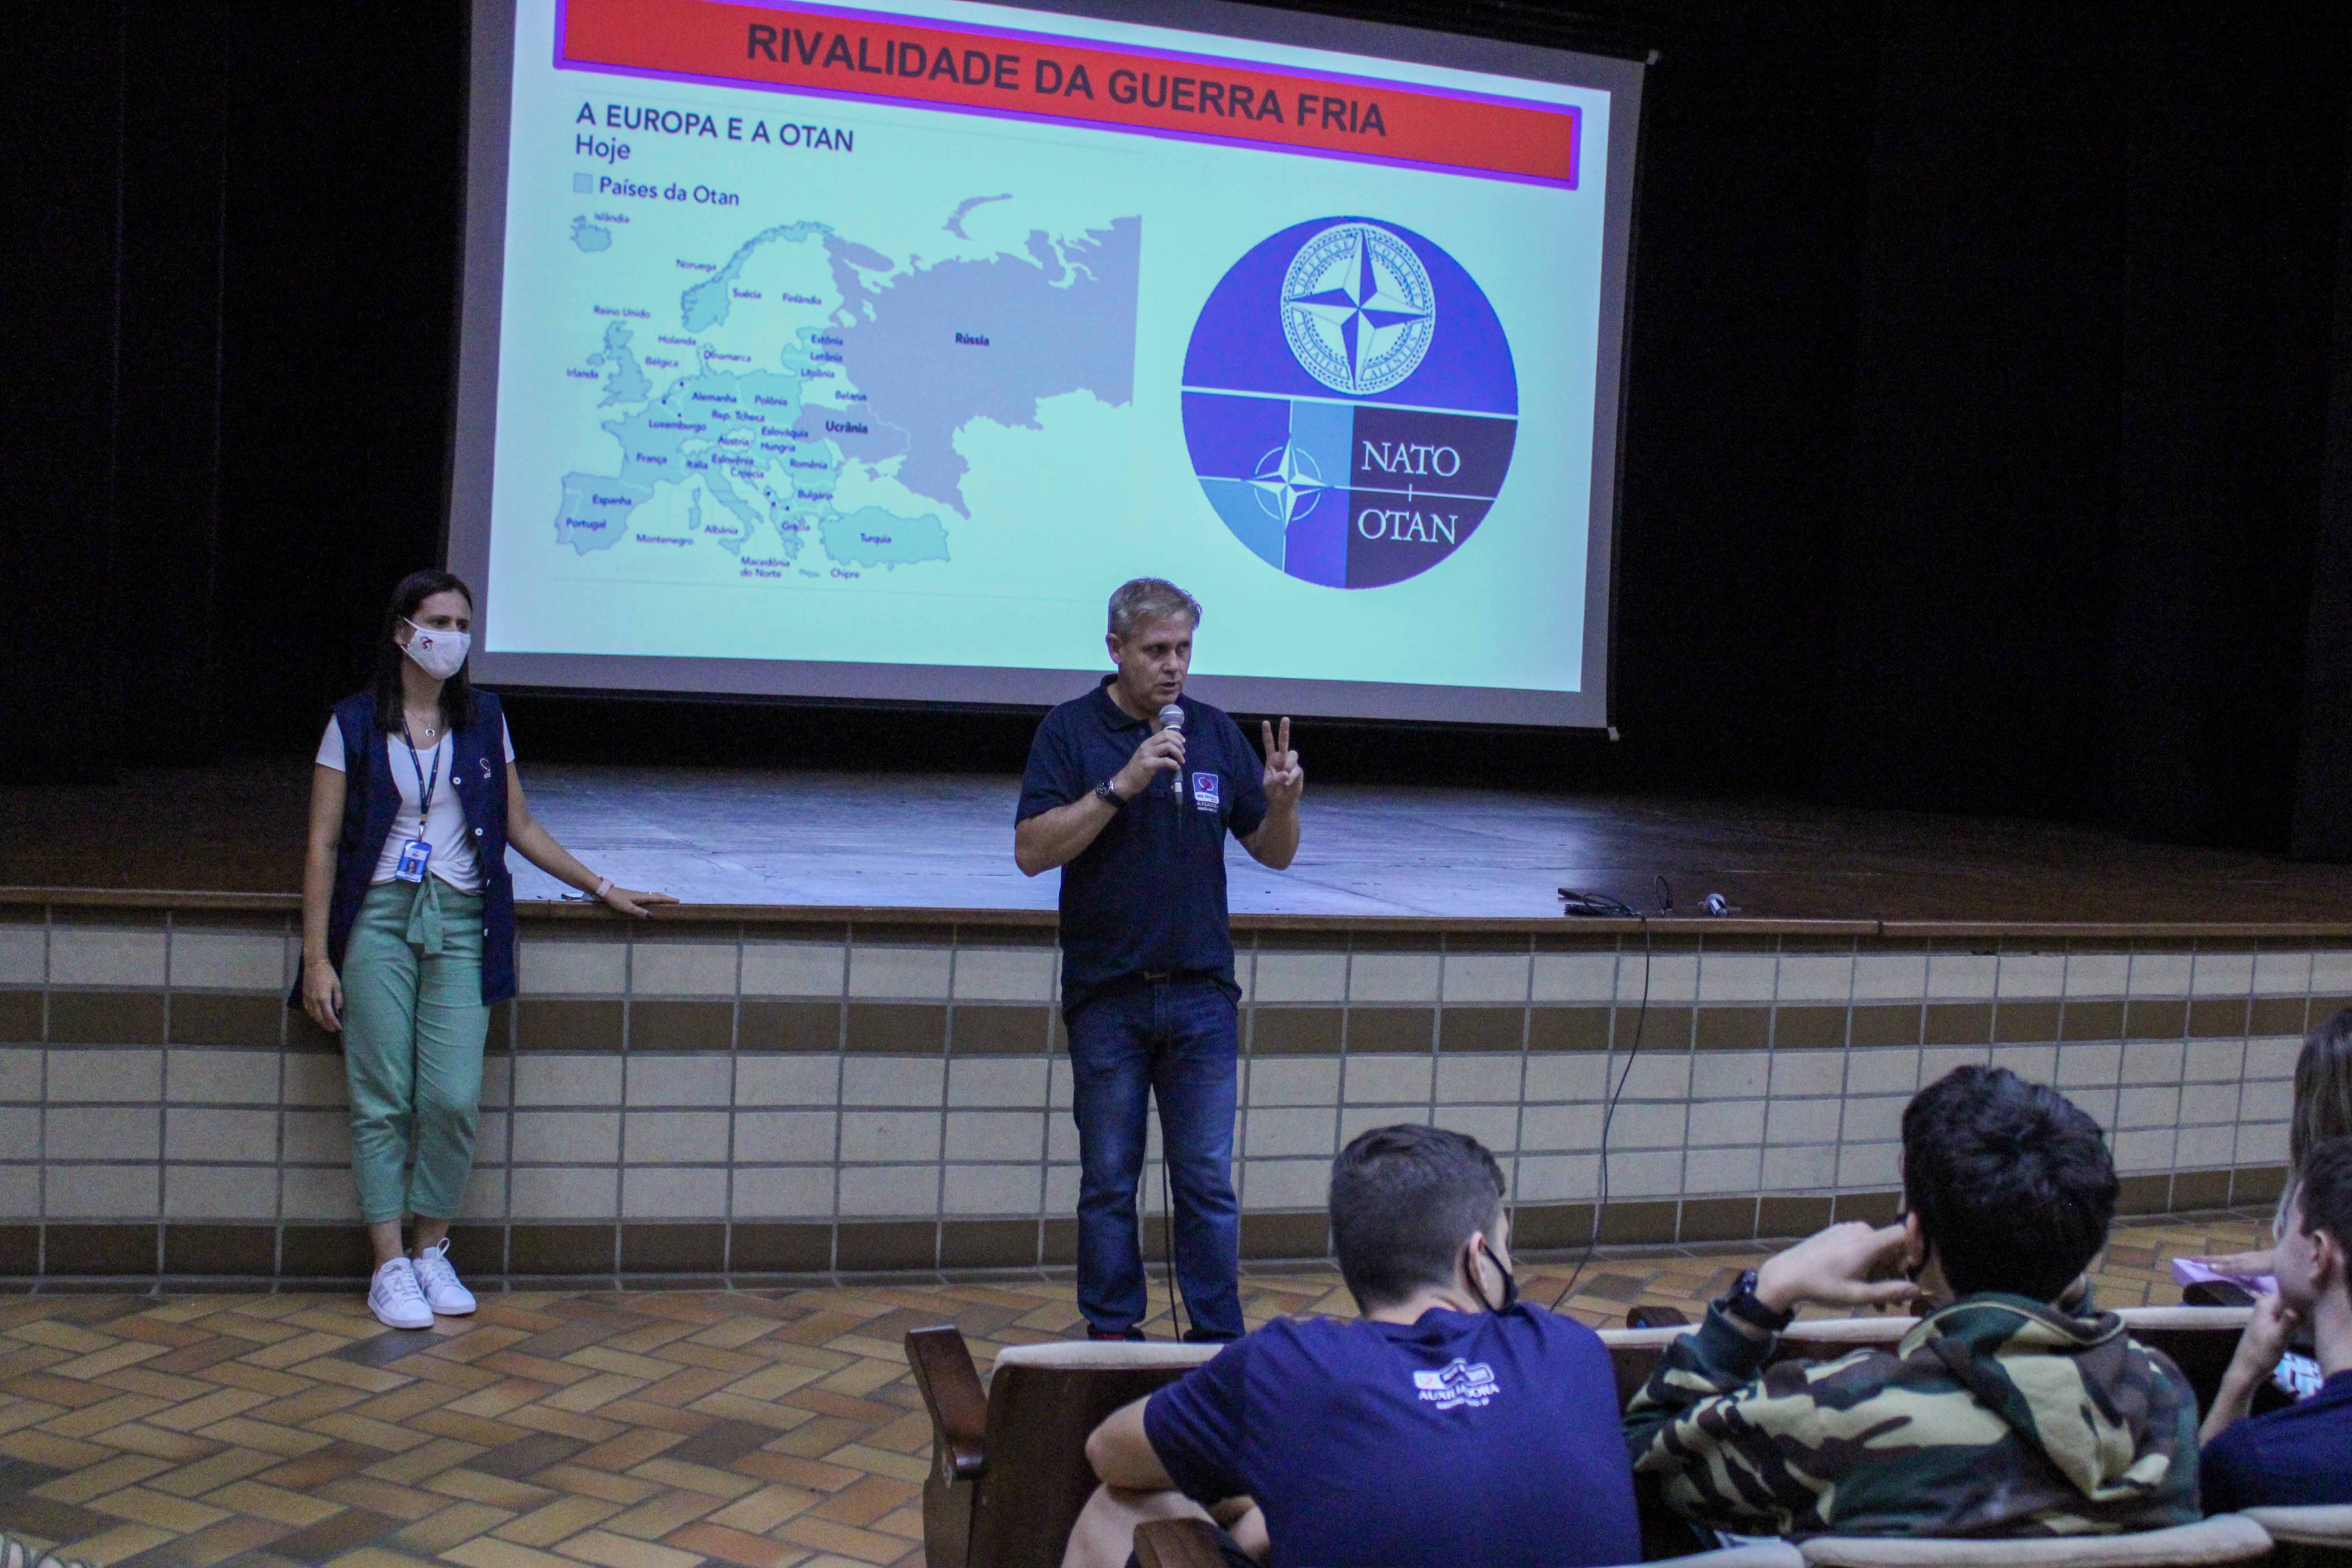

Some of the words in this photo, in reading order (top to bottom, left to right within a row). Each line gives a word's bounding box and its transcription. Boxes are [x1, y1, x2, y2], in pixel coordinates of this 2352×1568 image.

[747, 23, 1020, 90] RIVALIDADE
[1035, 59, 1094, 100] DA
[1108, 69, 1284, 124] GUERRA
[1297, 93, 1387, 137] FRIA
[576, 102, 596, 125] A
[606, 104, 718, 139] EUROPA
[728, 117, 743, 140] E
[751, 120, 771, 143] A
[779, 123, 854, 152] OTAN
[575, 133, 631, 165] Hoje
[600, 176, 658, 199] Países
[664, 183, 686, 202] da
[693, 185, 739, 206] Otan
[595, 212, 630, 224] Islândia
[677, 259, 716, 272] Noruega
[733, 288, 762, 299] Suécia
[783, 293, 821, 306] Finlândia
[594, 305, 620, 316] Reino
[623, 309, 650, 319] Unido
[659, 336, 696, 346] Holanda
[811, 334, 843, 346] Estônia
[955, 332, 989, 346] Rússia
[646, 356, 679, 368] Bélgica
[704, 350, 751, 362] Dinamarca
[810, 351, 843, 363] Letônia
[566, 368, 599, 379] Irlanda
[692, 392, 737, 403] Alemanha
[755, 395, 788, 407] Polônia
[712, 410, 730, 421] Rep.
[735, 411, 764, 422] Tcheca
[649, 420, 706, 433] Luxemburgo
[761, 426, 808, 439] Eslováquia
[826, 420, 868, 434] Ucrânia
[760, 442, 795, 454] Hungria
[637, 453, 667, 465] França
[686, 459, 708, 469] Itália
[1361, 440, 1460, 477] NATO
[592, 494, 632, 506] Espanha
[566, 517, 606, 531] Portugal
[1358, 509, 1458, 544] OTAN
[637, 535, 694, 547] Montenegro
[861, 533, 891, 544] Turquia
[741, 557, 789, 567] Macedônia
[756, 569, 781, 578] Norte
[830, 568, 860, 579] Chipre
